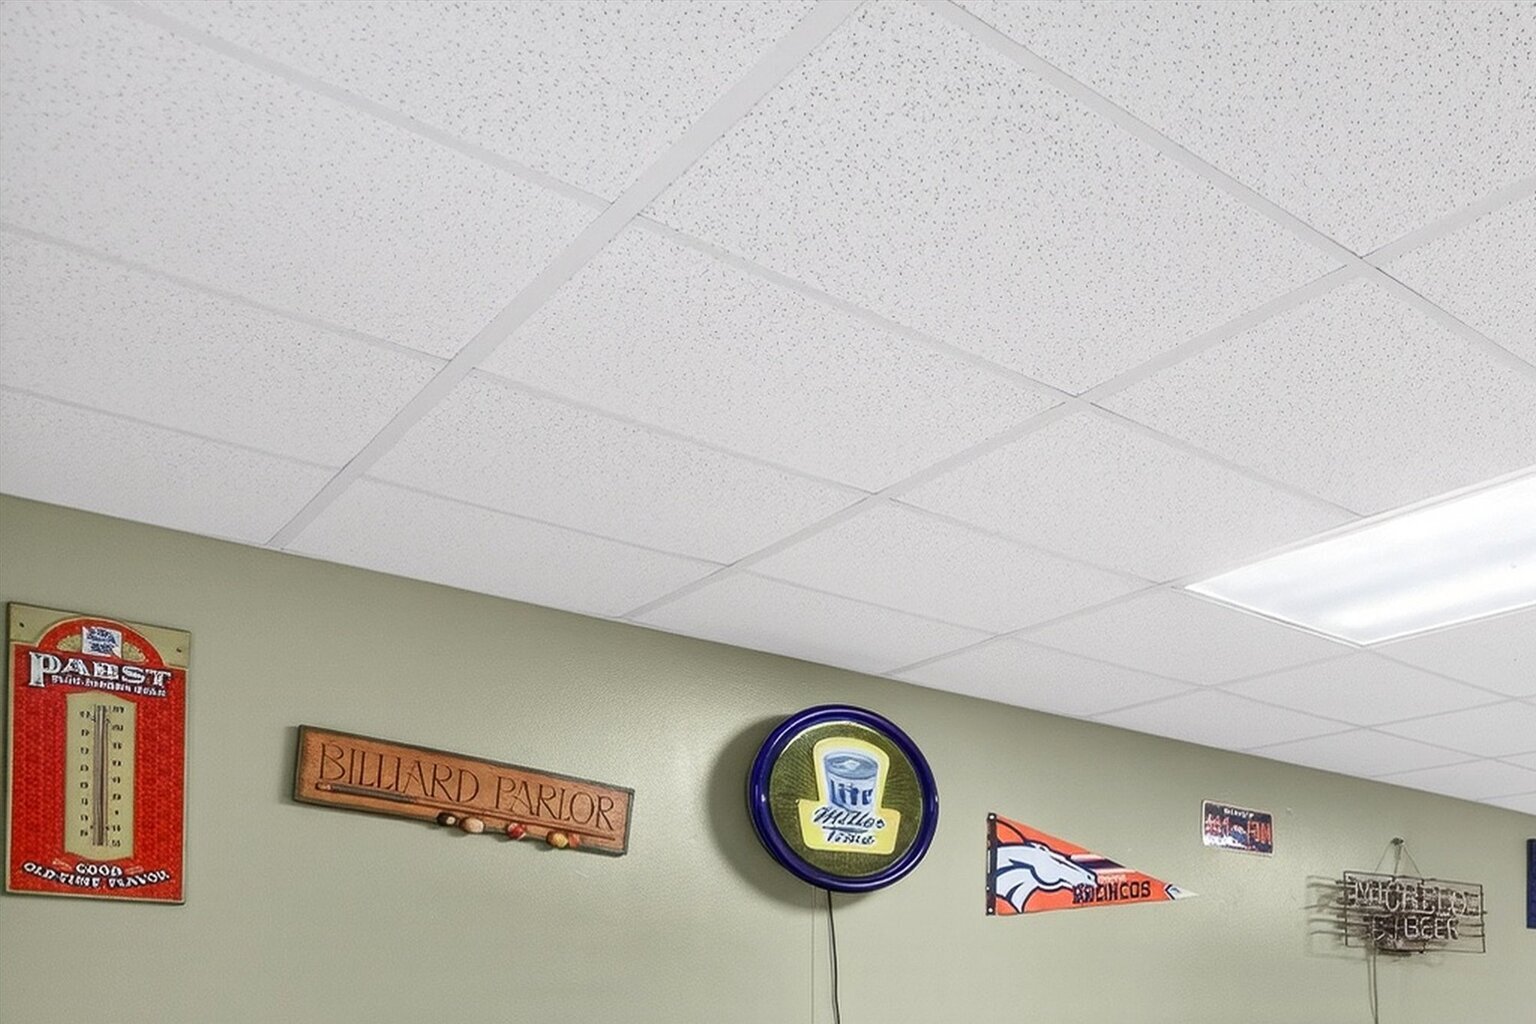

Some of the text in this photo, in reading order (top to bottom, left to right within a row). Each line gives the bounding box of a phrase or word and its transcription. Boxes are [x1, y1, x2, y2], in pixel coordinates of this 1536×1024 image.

[28, 651, 172, 688] PABST
[318, 742, 615, 831] BILLIARD PARLOR
[829, 779, 873, 806] Lite
[1072, 880, 1151, 905] BRONCOS
